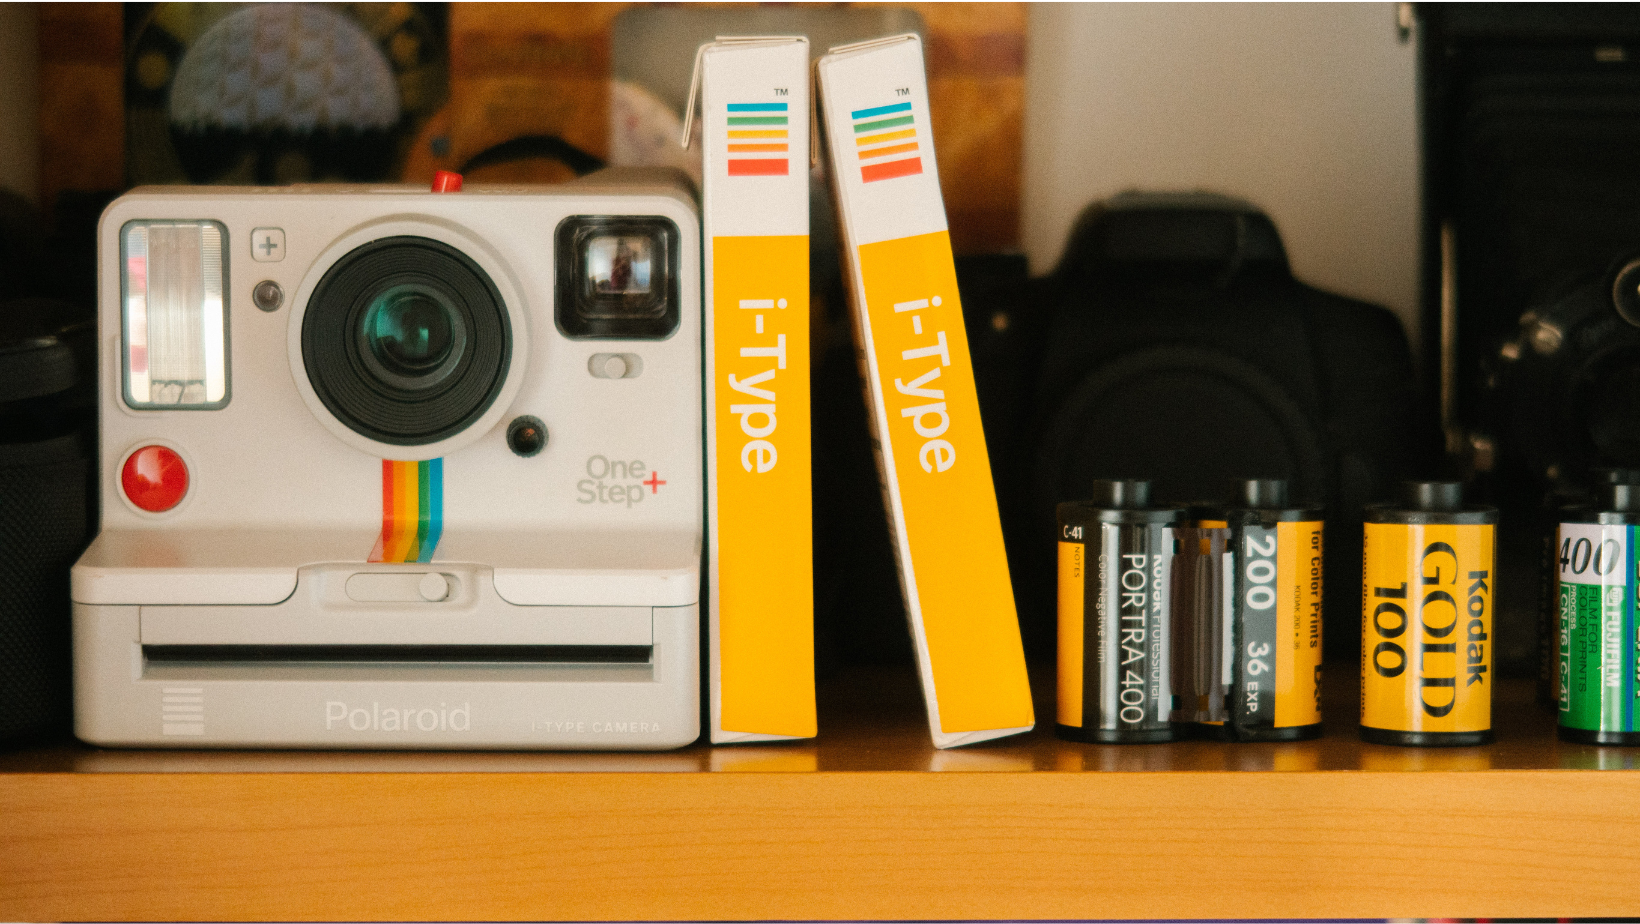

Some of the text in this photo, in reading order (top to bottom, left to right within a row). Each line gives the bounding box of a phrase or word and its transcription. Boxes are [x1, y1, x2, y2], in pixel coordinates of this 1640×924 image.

[774, 88, 789, 97] TM
[895, 87, 911, 97] TM
[728, 297, 788, 474] i-Type
[893, 295, 956, 474] i-Type
[585, 454, 647, 480] One
[1063, 524, 1083, 540] C-41
[1560, 537, 1621, 577] 400
[1095, 554, 1109, 663] Color Negative Film
[1246, 535, 1276, 715] 200 36 EXP.
[1293, 585, 1302, 613] KODAK
[1309, 530, 1321, 649] for Color Prints
[1372, 581, 1409, 678] 100
[1419, 541, 1458, 718] GOLD
[1466, 569, 1489, 688] Kodak
[1588, 586, 1598, 654] FILM FOR
[1120, 554, 1147, 724] PORTRA 400
[1560, 593, 1568, 702] CN-16 C-41
[1578, 585, 1588, 693] COLOR PRINTS
[1606, 611, 1622, 688] FUJIFILM
[325, 701, 471, 732] Polaroid
[592, 721, 662, 734] CAMERA
